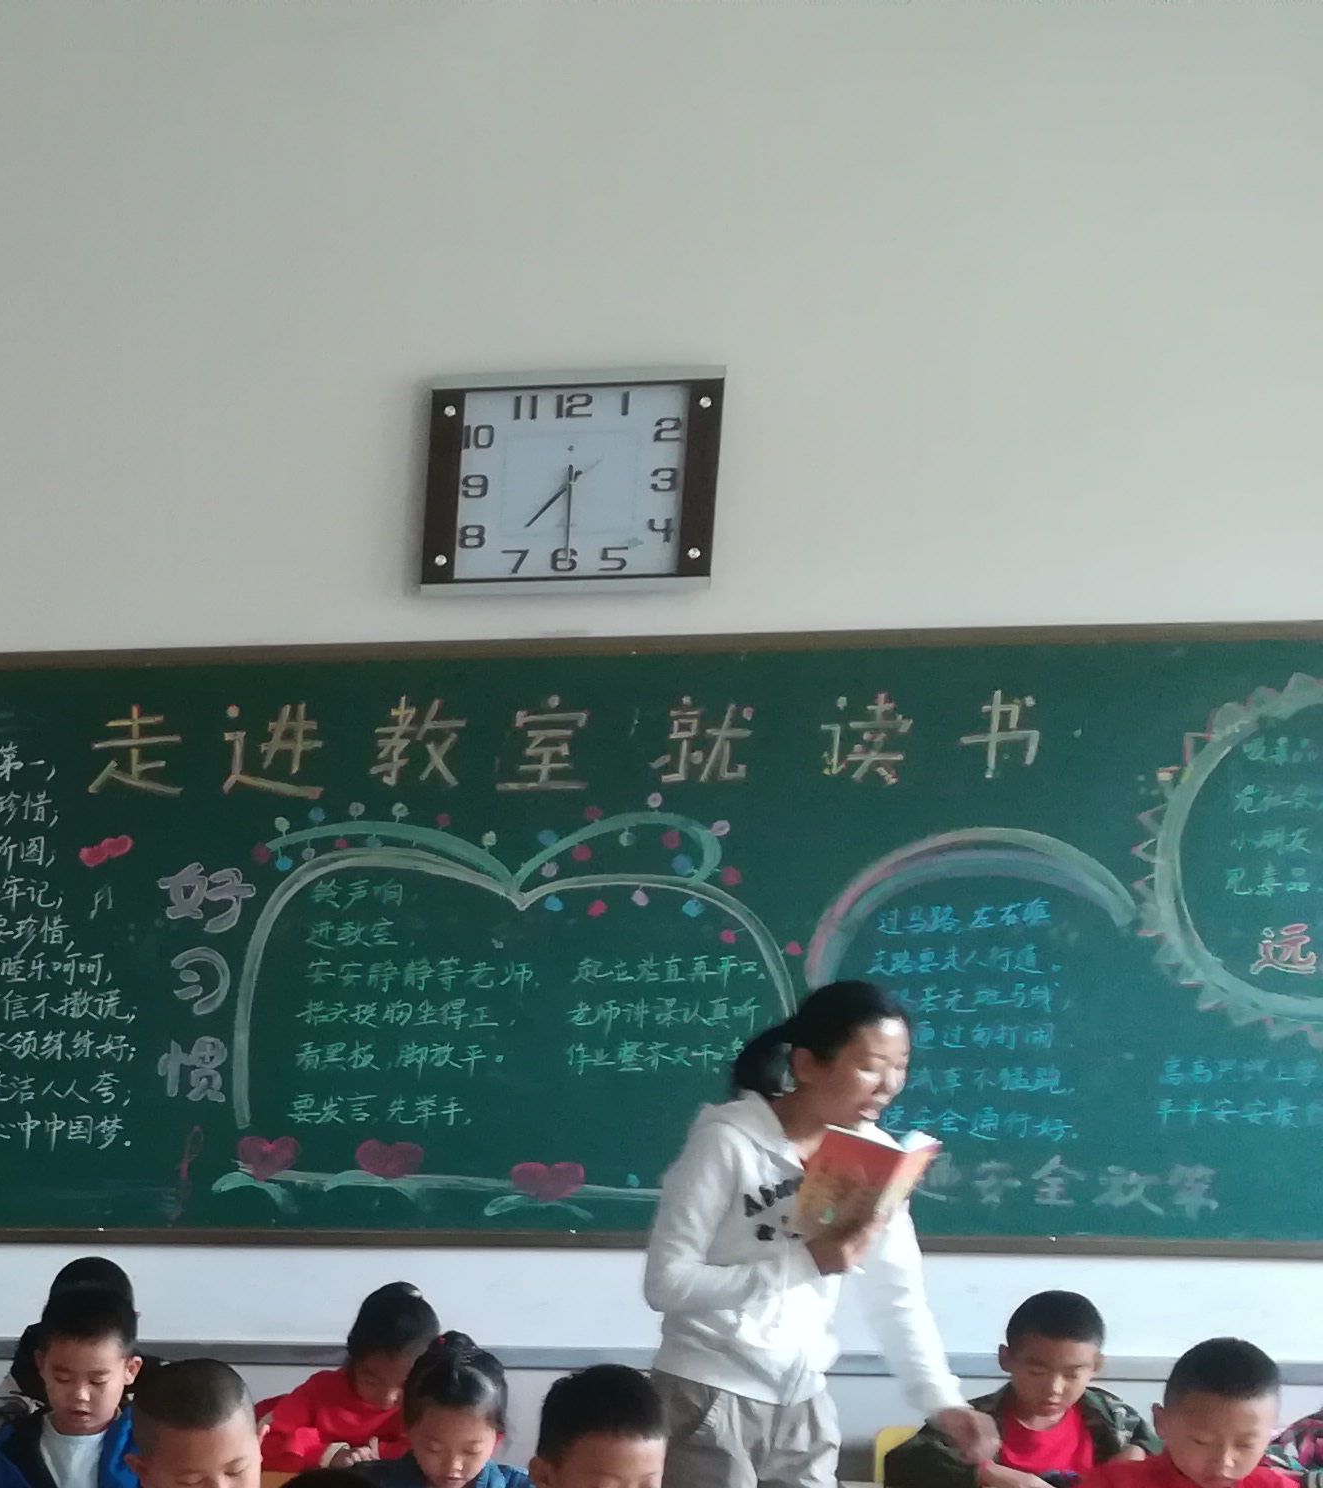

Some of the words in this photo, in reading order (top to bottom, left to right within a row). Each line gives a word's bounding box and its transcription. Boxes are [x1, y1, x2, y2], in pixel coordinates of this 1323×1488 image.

[554, 392, 593, 418] 12
[619, 390, 630, 417] 1
[462, 423, 495, 450] 10
[652, 416, 682, 443] 2
[461, 473, 489, 499] 9
[650, 467, 677, 493] 3
[458, 523, 487, 550] 8
[648, 517, 675, 544] 4
[500, 548, 530, 575] 7
[550, 547, 578, 573] 6
[597, 546, 629, 572] 5
[88, 689, 1041, 799] 走进教室就读书
[157, 862, 257, 1103] 好习惯
